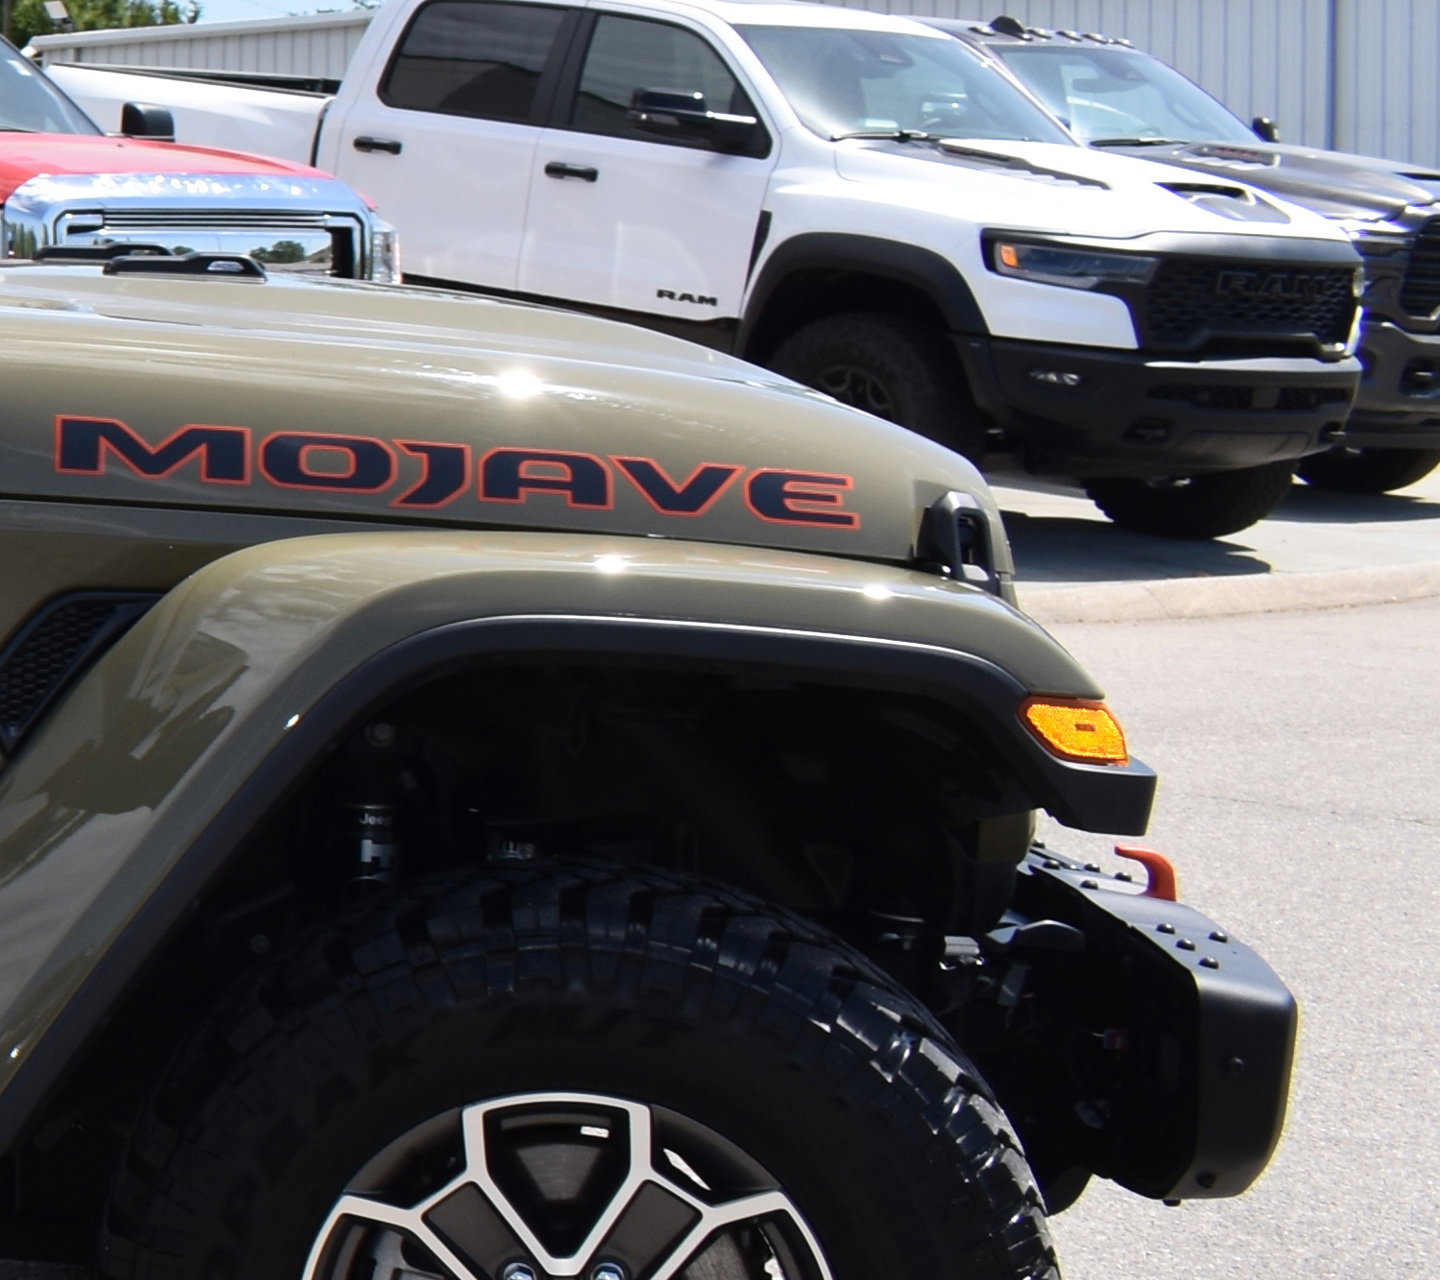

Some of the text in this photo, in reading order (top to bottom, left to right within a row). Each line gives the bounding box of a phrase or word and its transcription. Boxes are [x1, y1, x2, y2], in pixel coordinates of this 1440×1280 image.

[656, 288, 718, 307] RAM
[1216, 271, 1327, 299] RAM
[55, 414, 861, 529] MOJAVE
